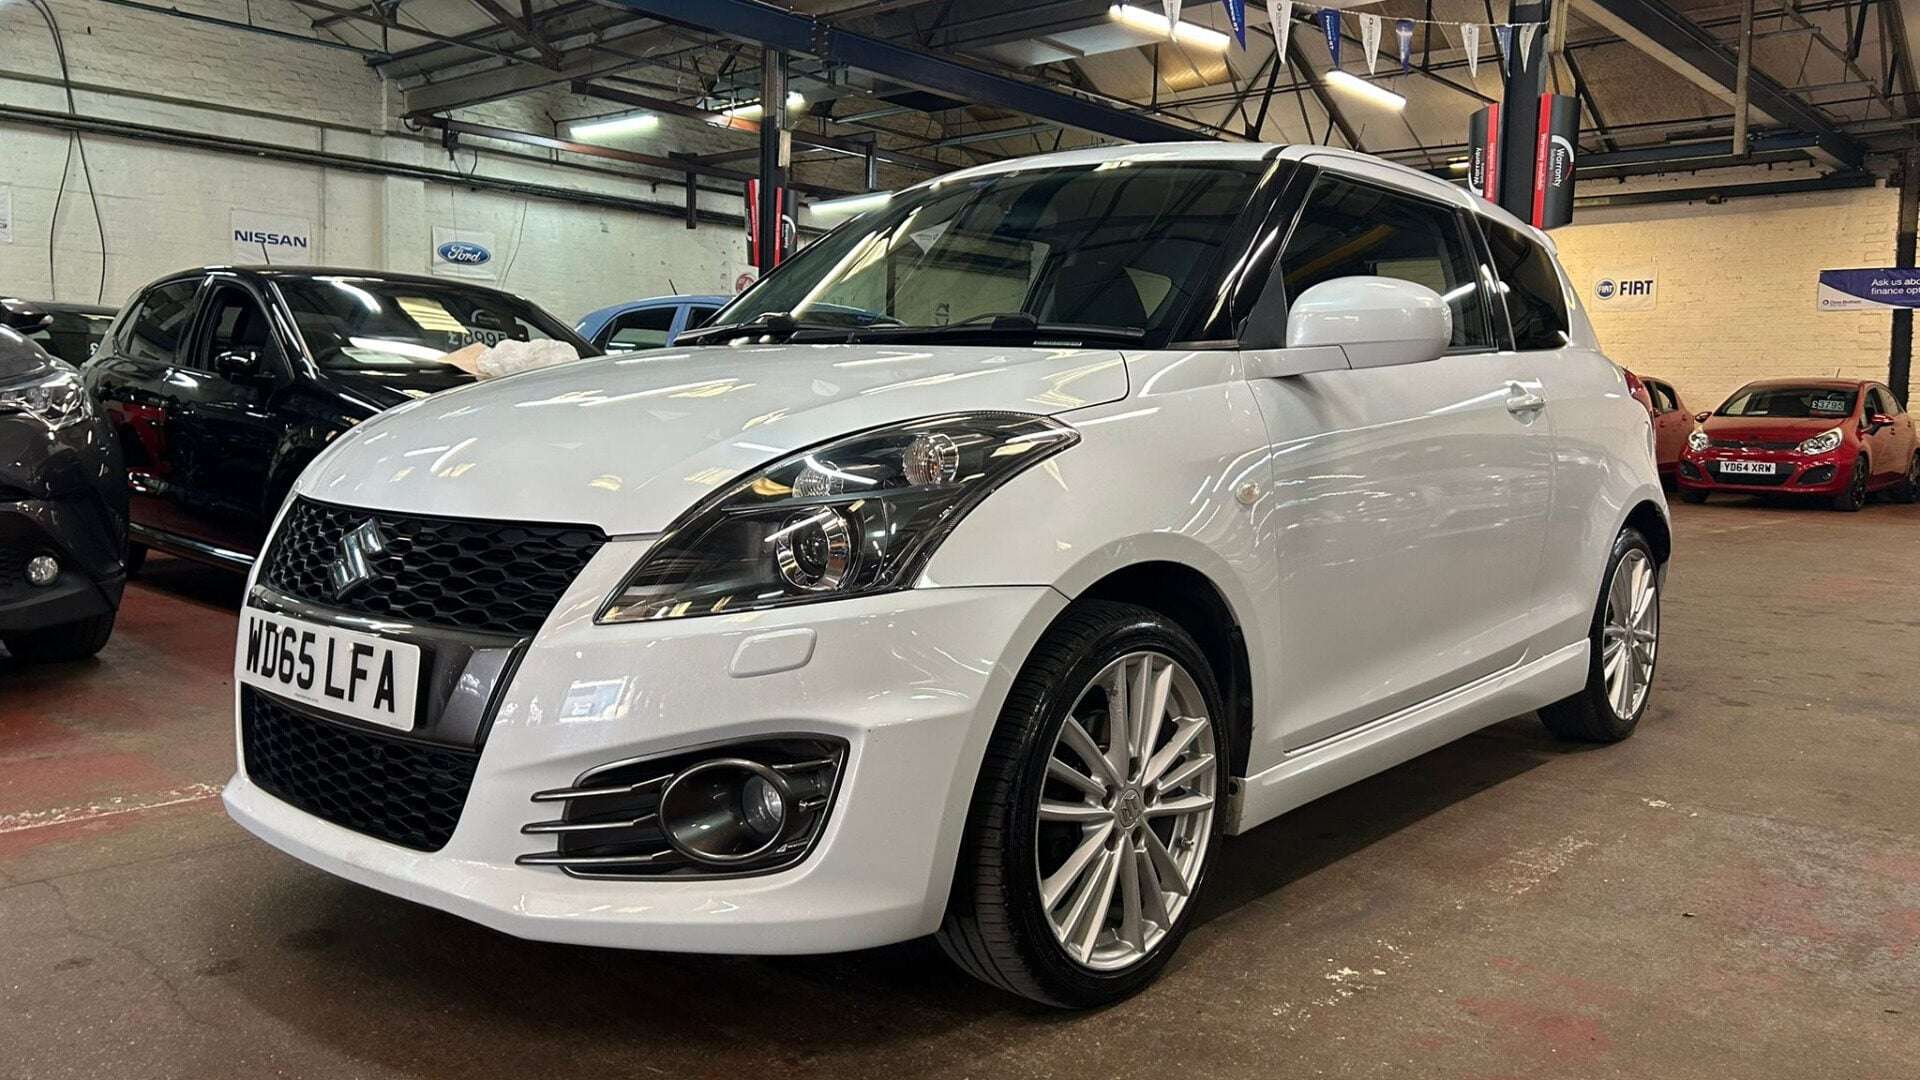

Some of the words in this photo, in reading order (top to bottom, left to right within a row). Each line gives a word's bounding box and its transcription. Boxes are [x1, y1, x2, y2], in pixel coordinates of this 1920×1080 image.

[1552, 148, 1565, 187] Warranty
[234, 230, 307, 248] NISSAN
[447, 246, 482, 261] Ford
[1620, 280, 1653, 296] FIAT
[1871, 278, 1888, 286] Ask
[1871, 287, 1904, 295] finance
[1724, 462, 1748, 471] YD64
[1751, 463, 1771, 472] XRW
[246, 616, 316, 690] WD65
[325, 637, 395, 713] LFA
